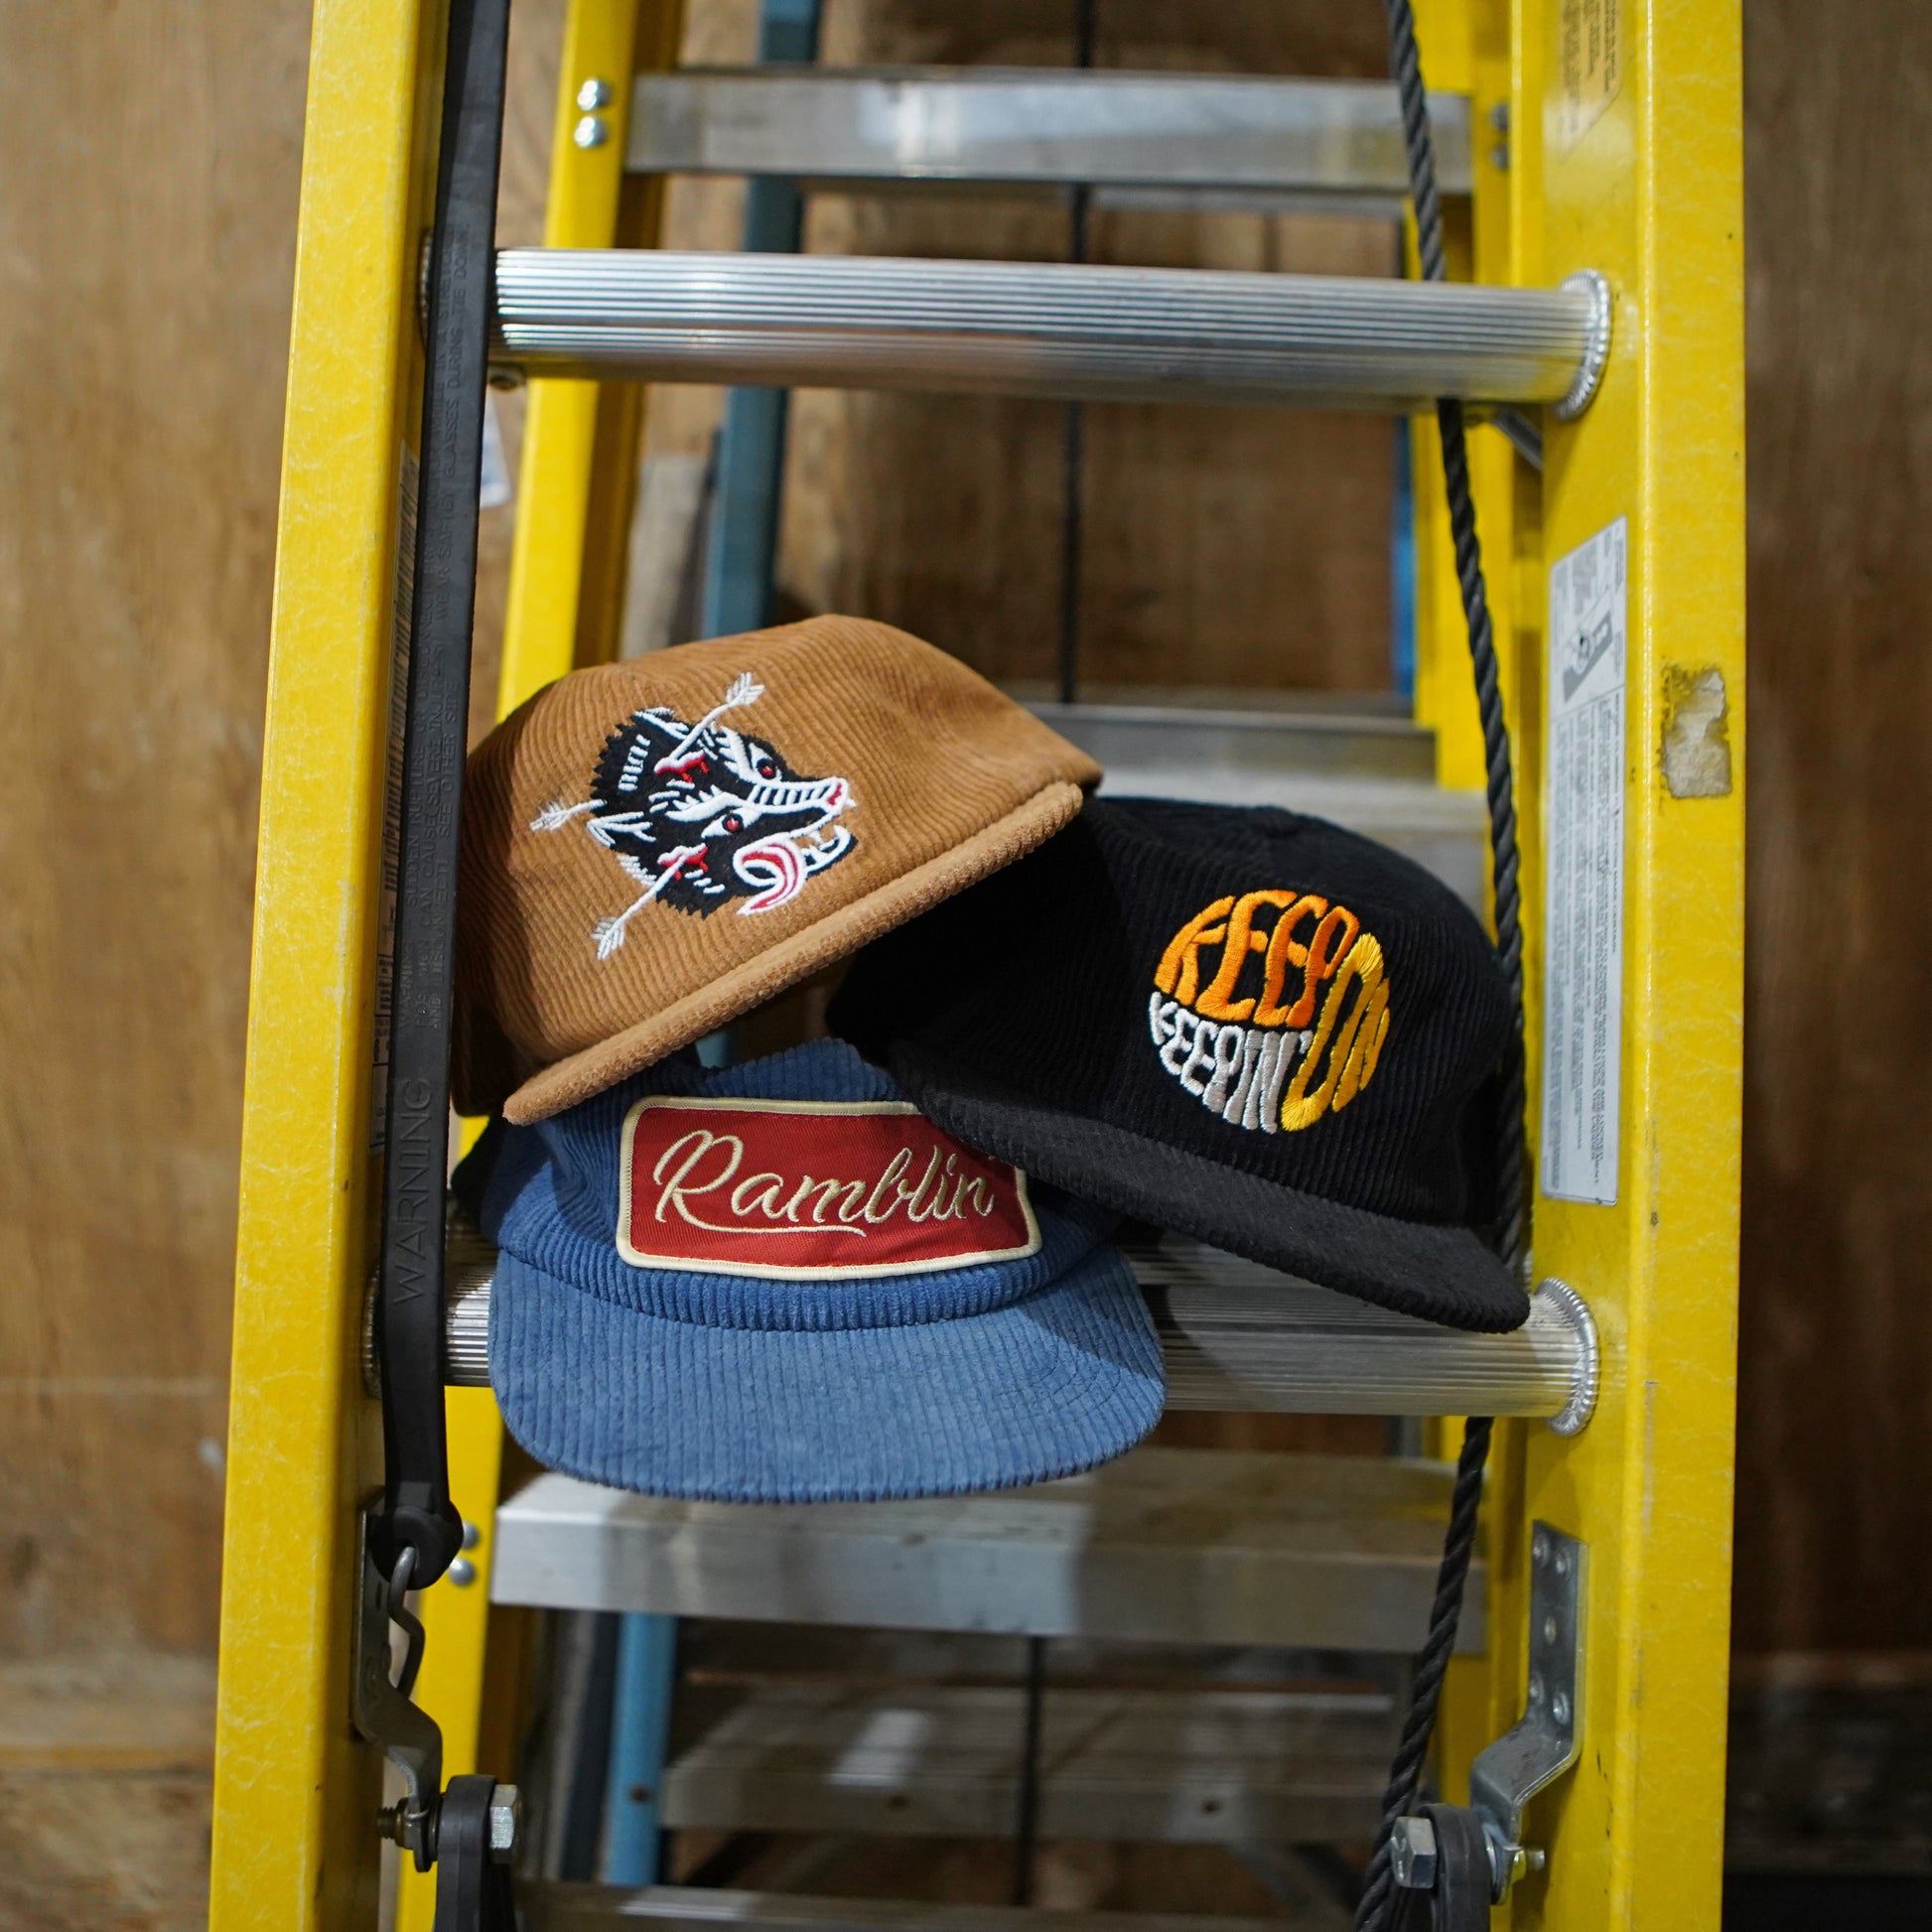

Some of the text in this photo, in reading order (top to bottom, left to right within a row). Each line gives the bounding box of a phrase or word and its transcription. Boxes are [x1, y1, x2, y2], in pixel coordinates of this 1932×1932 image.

[443, 398, 460, 479] GLASSES
[408, 745, 425, 824] RUPTURE
[427, 740, 442, 806] SEVERE
[441, 733, 457, 792] OTHER
[421, 815, 437, 878] CAUSE
[437, 802, 453, 838] SEE
[405, 834, 420, 905] SUDDEN
[419, 889, 433, 927] CAN
[1153, 889, 1361, 1029] KEEP
[428, 994, 443, 1031] AND
[1281, 932, 1391, 1133] ON
[393, 1078, 433, 1305] WARNING
[652, 1129, 994, 1238] Ramblin
